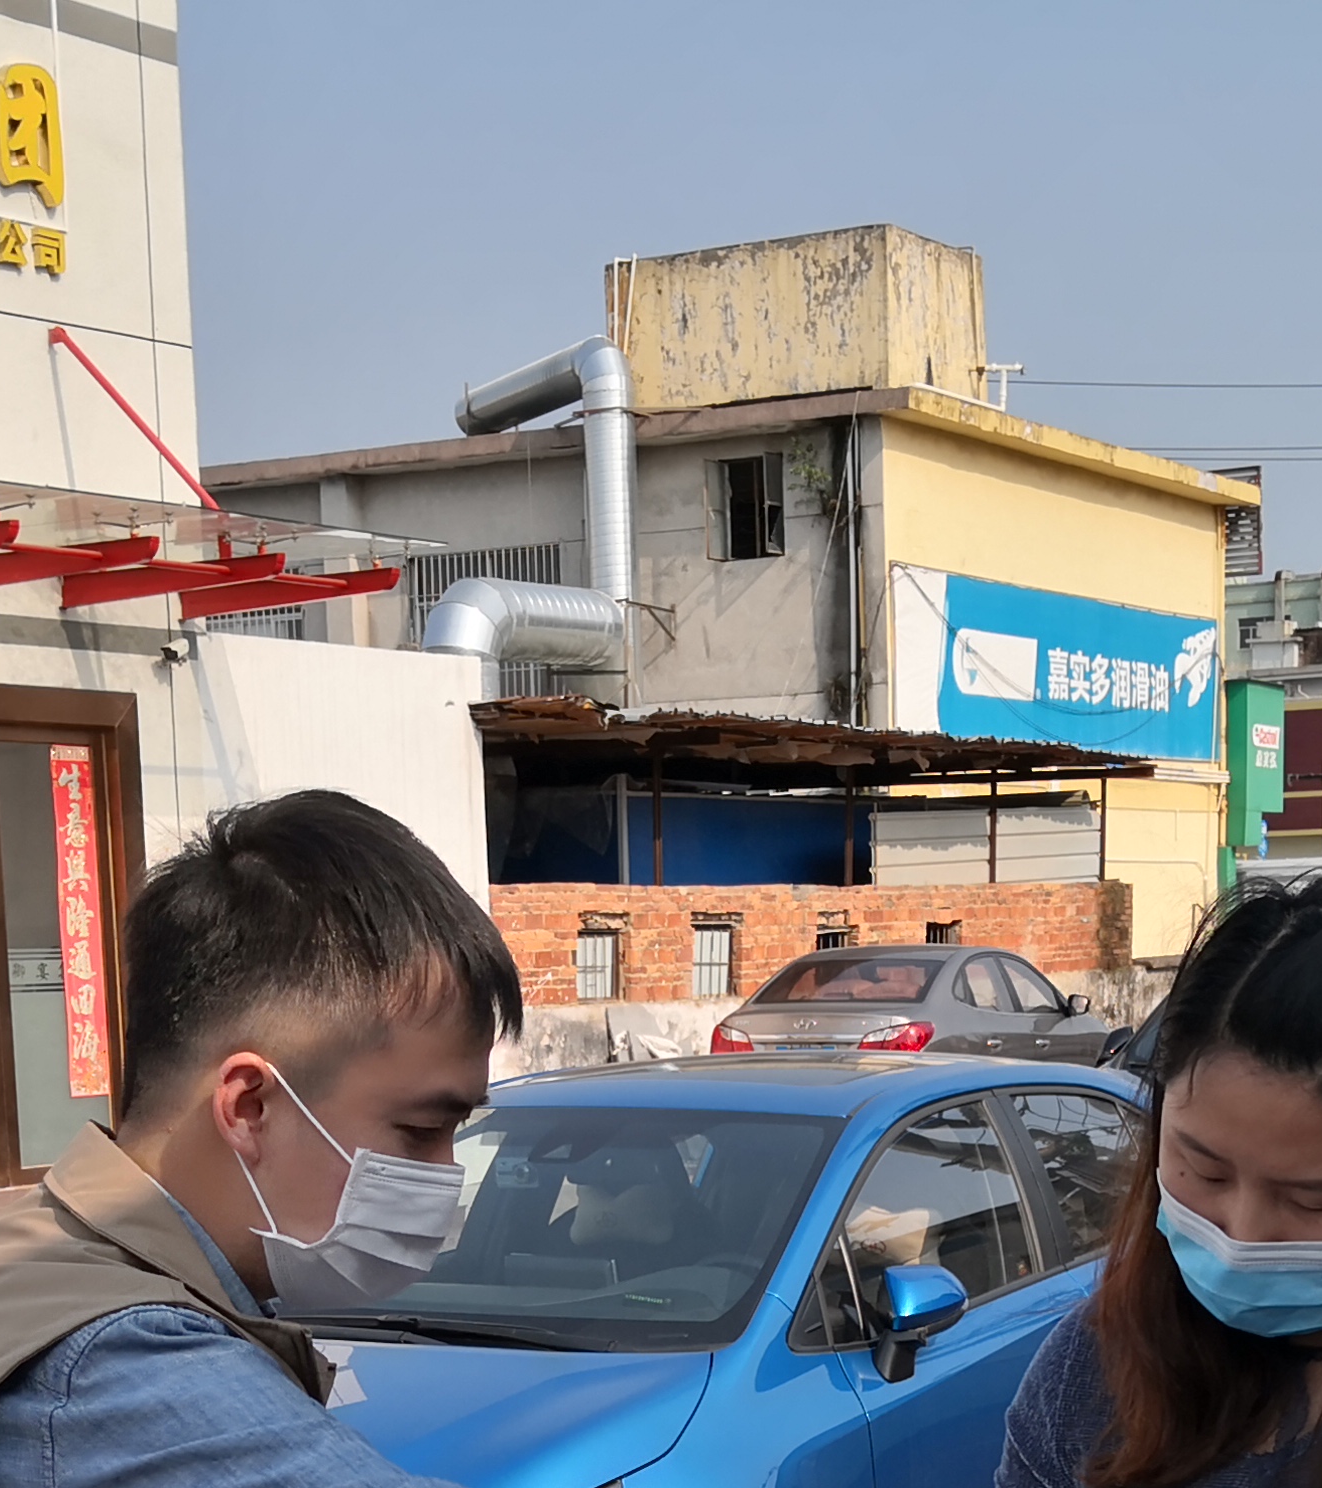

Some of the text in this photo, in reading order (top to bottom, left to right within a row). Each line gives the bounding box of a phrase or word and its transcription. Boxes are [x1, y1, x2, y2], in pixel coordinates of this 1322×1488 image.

[1047, 647, 1170, 713] 嘉实多润滑油
